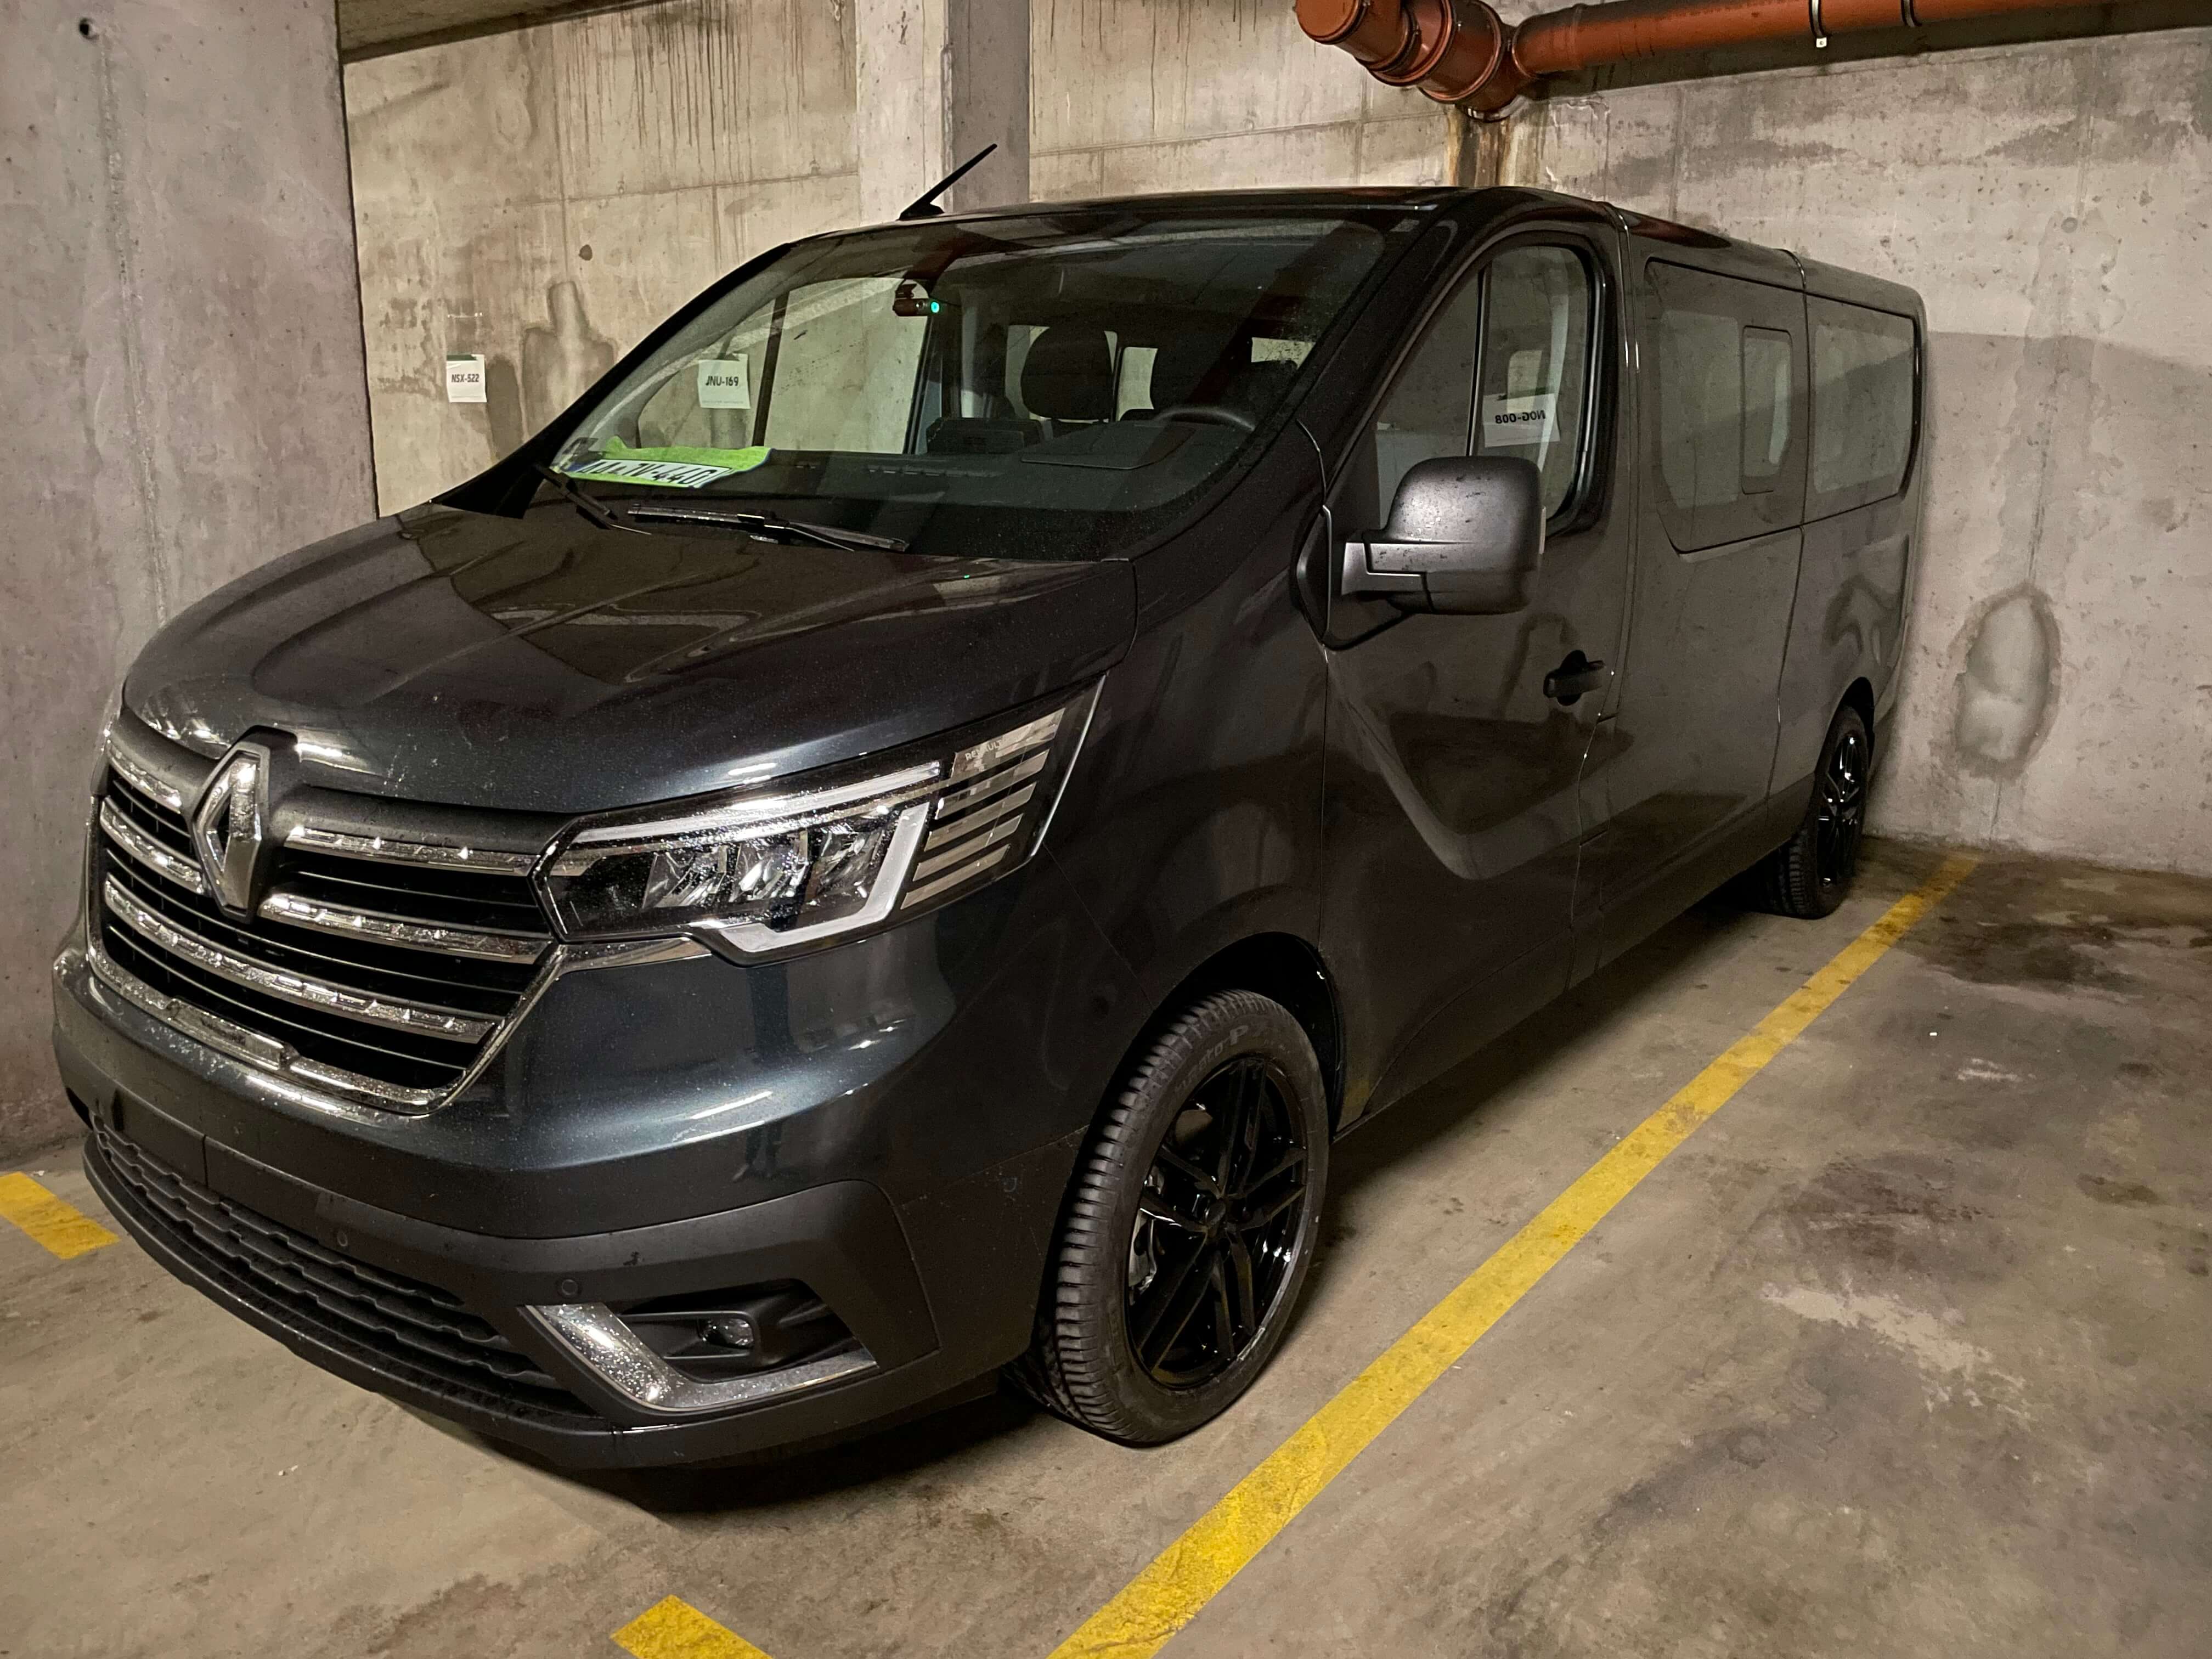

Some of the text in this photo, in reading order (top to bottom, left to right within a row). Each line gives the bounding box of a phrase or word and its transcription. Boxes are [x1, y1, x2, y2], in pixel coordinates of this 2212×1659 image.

[451, 374, 479, 383] NSX-522
[705, 376, 739, 386] JNU-169
[965, 740, 1002, 761] REULT
